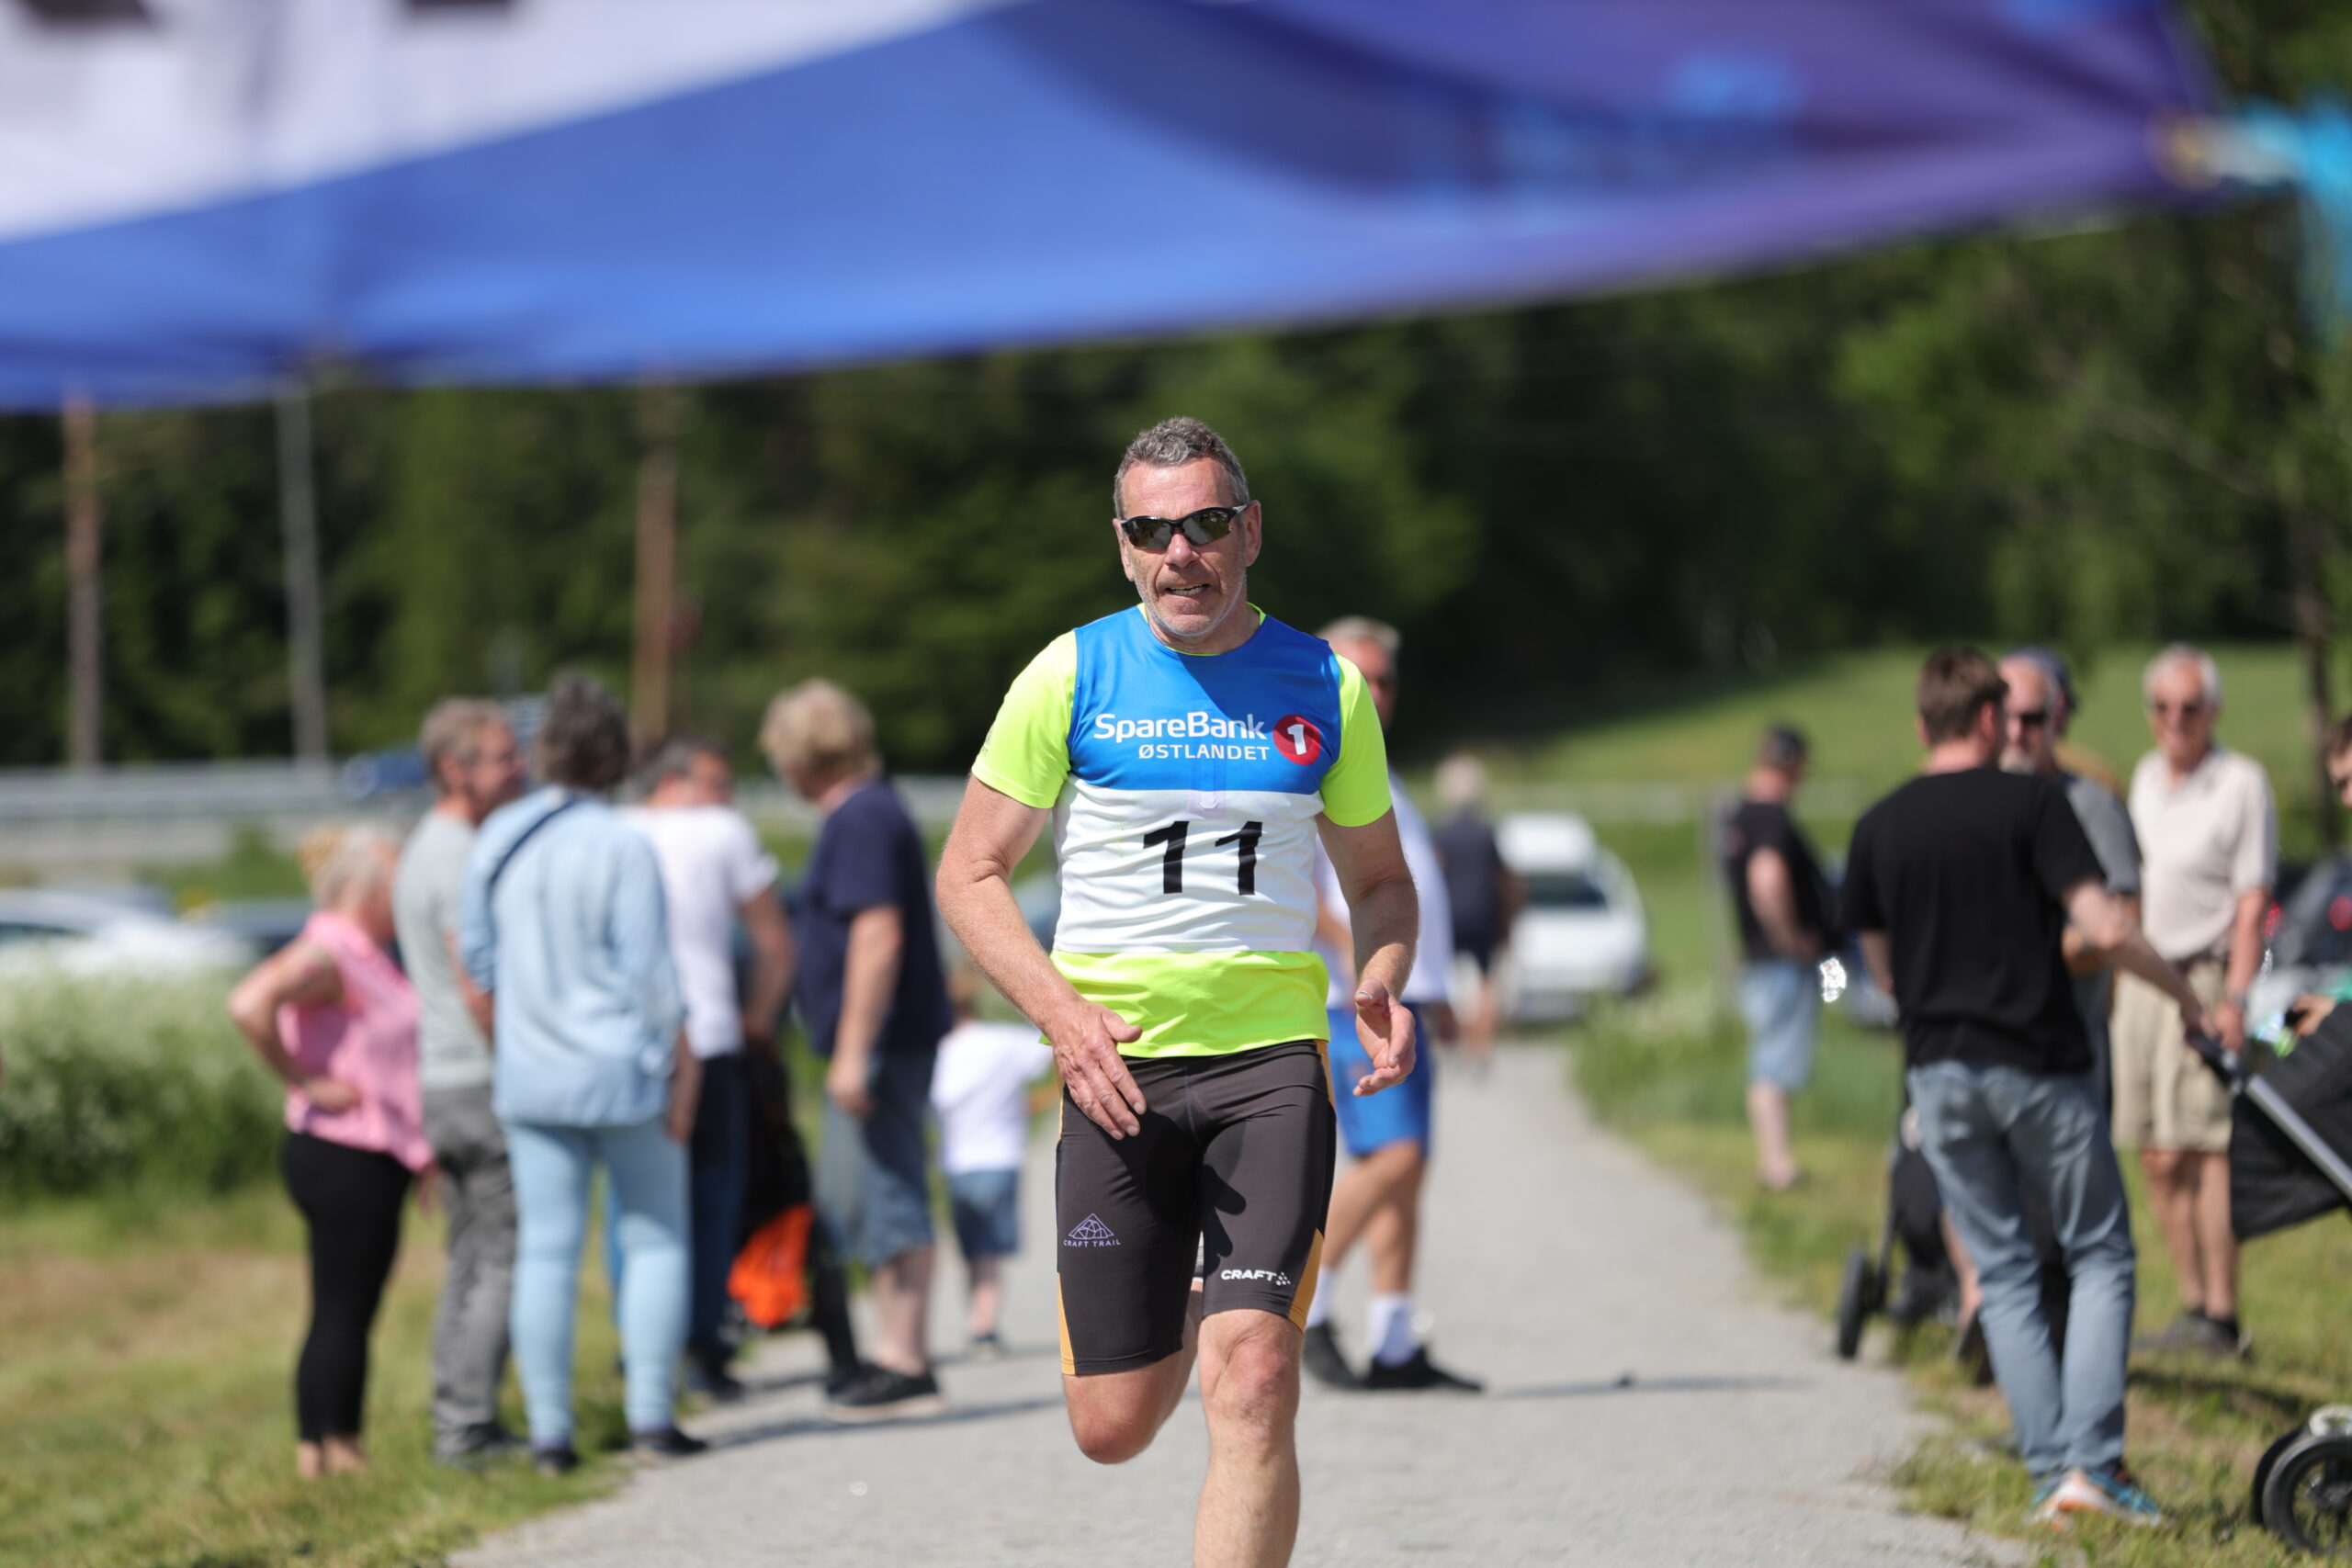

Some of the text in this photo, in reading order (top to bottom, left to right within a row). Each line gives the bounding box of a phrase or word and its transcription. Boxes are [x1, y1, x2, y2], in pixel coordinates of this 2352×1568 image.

[1093, 711, 1268, 742] SpareBank
[1138, 744, 1271, 761] ØSTLANDET
[1143, 820, 1263, 896] 11
[1092, 1238, 1121, 1247] TRAIL
[1220, 1269, 1276, 1282] CRAFT
